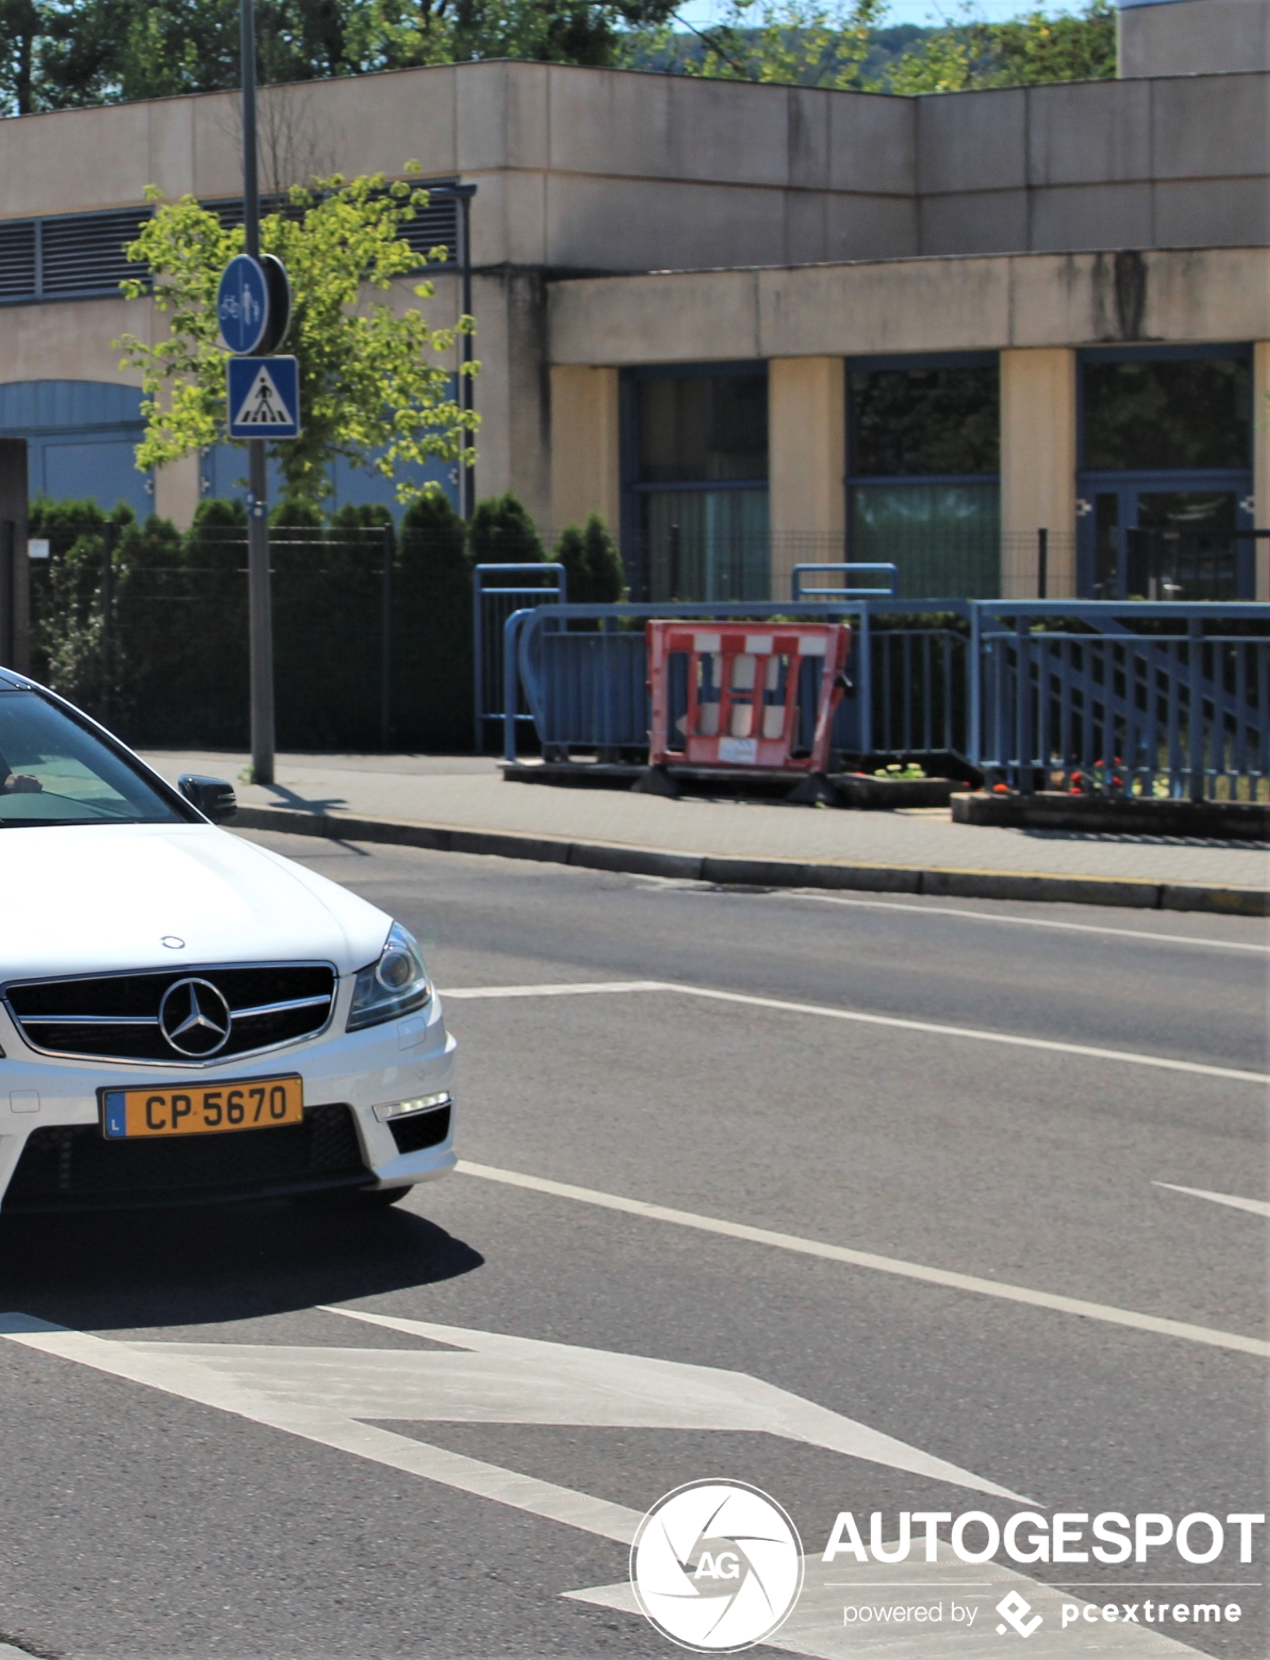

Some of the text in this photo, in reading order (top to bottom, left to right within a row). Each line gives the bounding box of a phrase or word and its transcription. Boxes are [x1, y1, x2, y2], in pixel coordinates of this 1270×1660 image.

[145, 1085, 287, 1130] CP 5670
[111, 1118, 120, 1131] L
